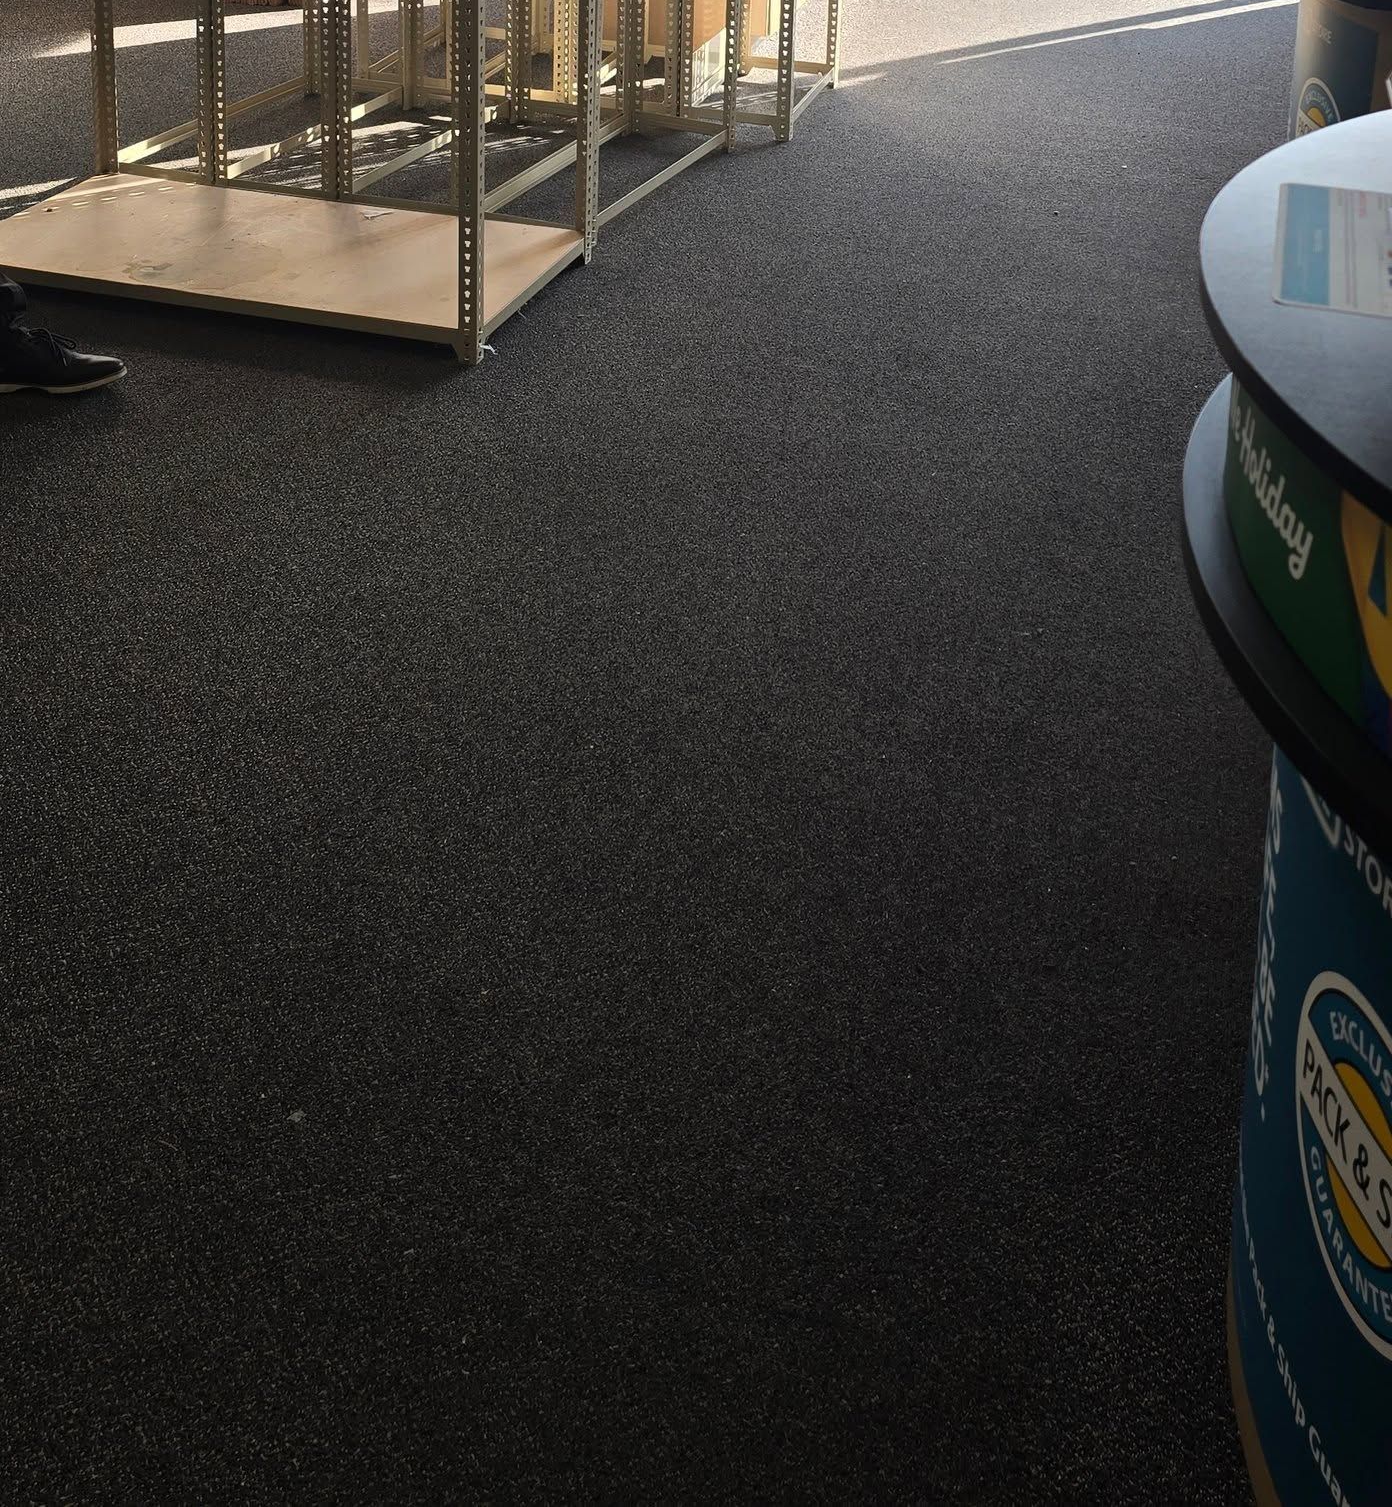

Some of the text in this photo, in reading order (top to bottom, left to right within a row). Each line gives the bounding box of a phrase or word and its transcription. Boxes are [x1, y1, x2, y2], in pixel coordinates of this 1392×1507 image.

[1239, 406, 1314, 581] Holiday
[1302, 1037, 1350, 1165] PACK
[1352, 1142, 1370, 1201] &
[1330, 1011, 1392, 1103] EXCLUS
[1276, 1344, 1306, 1428] Ship
